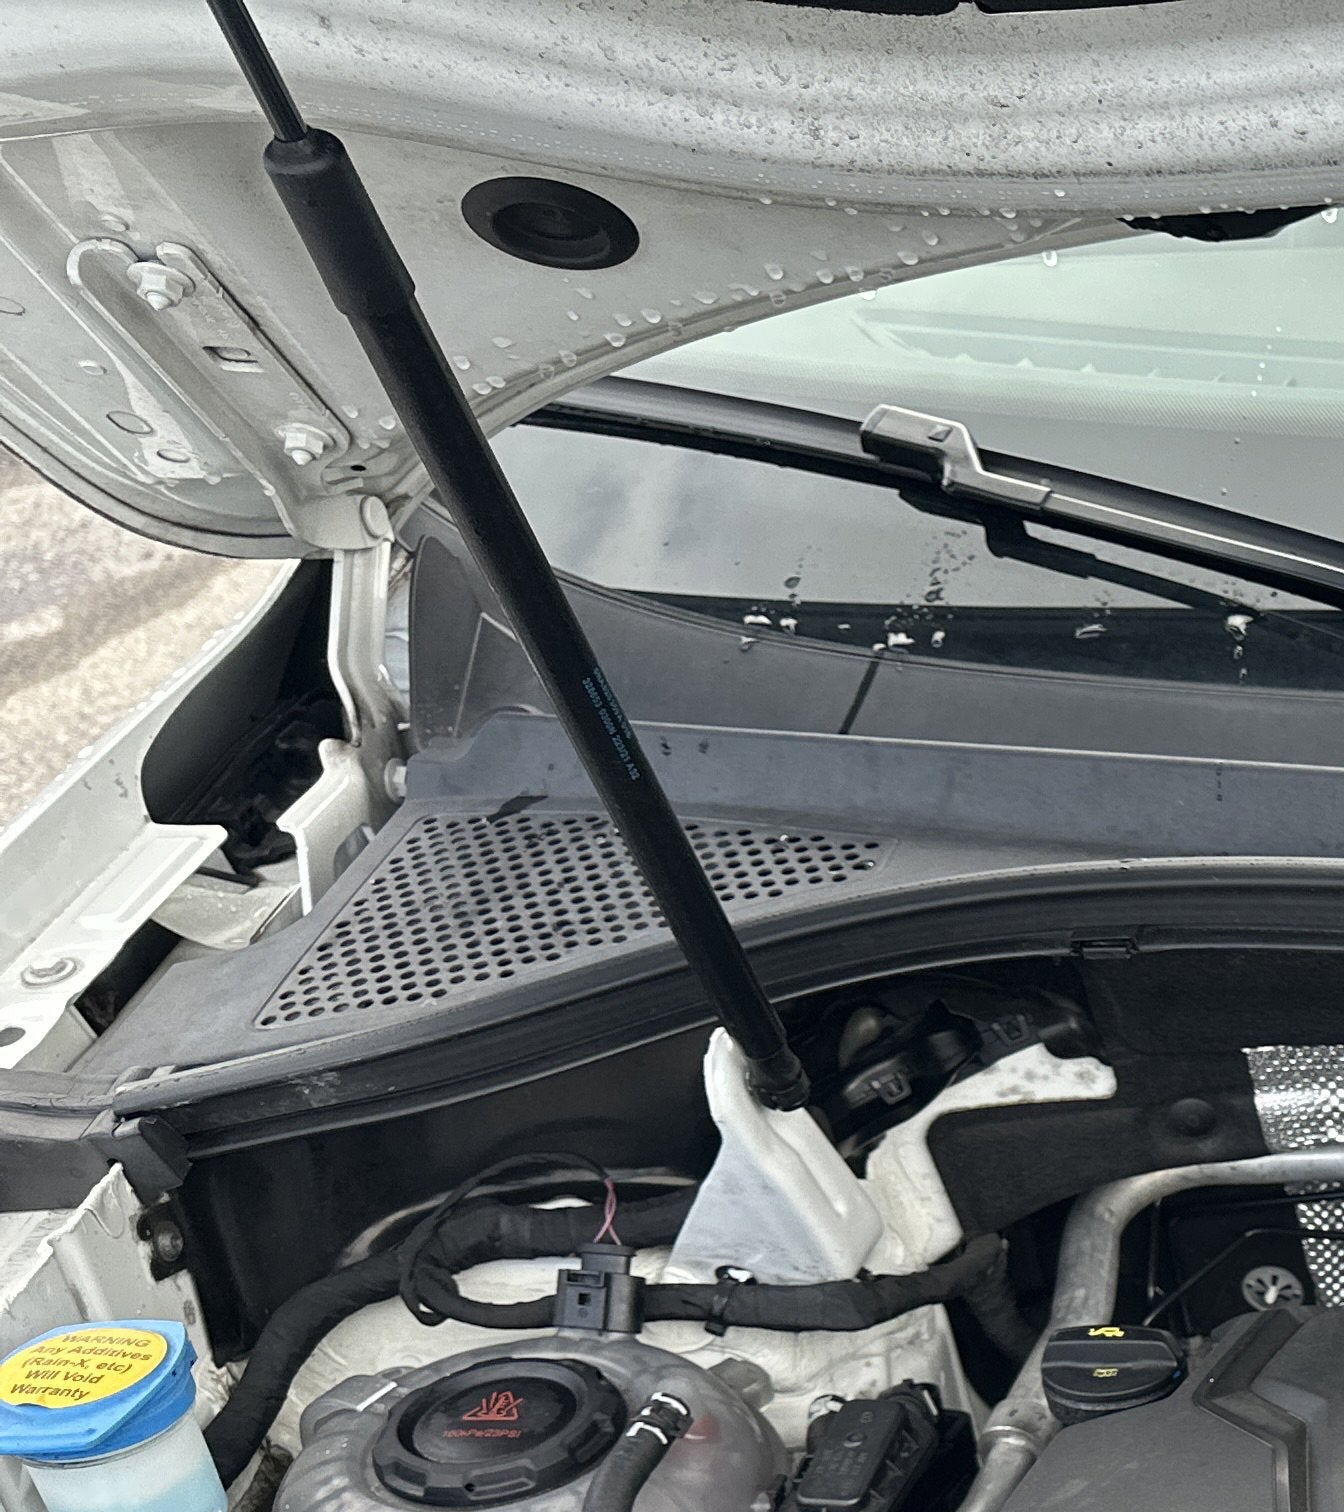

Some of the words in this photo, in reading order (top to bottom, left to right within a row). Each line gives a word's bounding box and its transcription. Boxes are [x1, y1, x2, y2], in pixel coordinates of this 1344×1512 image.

[62, 1335, 153, 1347] WARNING
[30, 1344, 62, 1355] Any
[66, 1345, 153, 1361] Additives
[21, 1357, 91, 1370] (Rain-X,
[96, 1361, 133, 1374] etc)
[24, 1369, 61, 1380] Will
[63, 1371, 103, 1384] Void
[10, 1383, 90, 1400] Warranty
